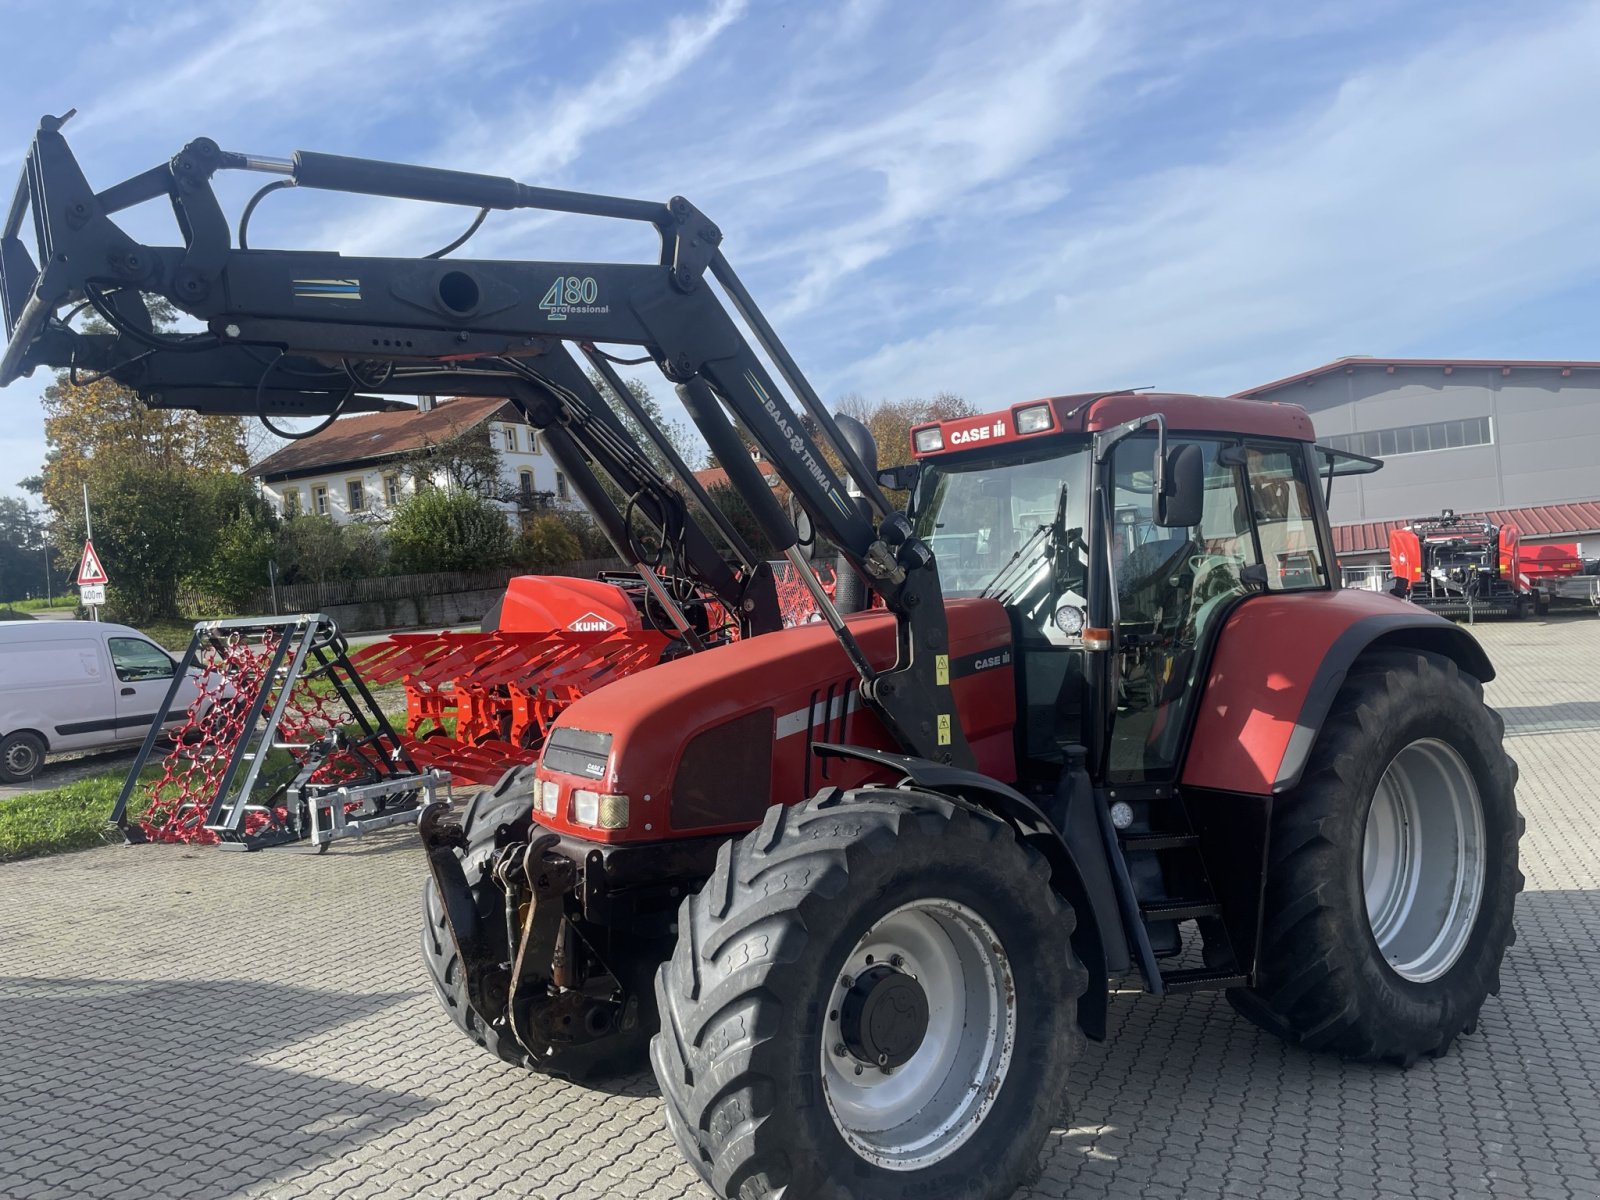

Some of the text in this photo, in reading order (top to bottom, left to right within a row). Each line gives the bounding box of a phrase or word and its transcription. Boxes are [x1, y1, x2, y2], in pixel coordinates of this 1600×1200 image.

[539, 277, 598, 320] 480
[551, 305, 609, 314] professional
[951, 426, 990, 445] CASE
[575, 621, 607, 632] KUHN
[975, 655, 1001, 670] CASE
